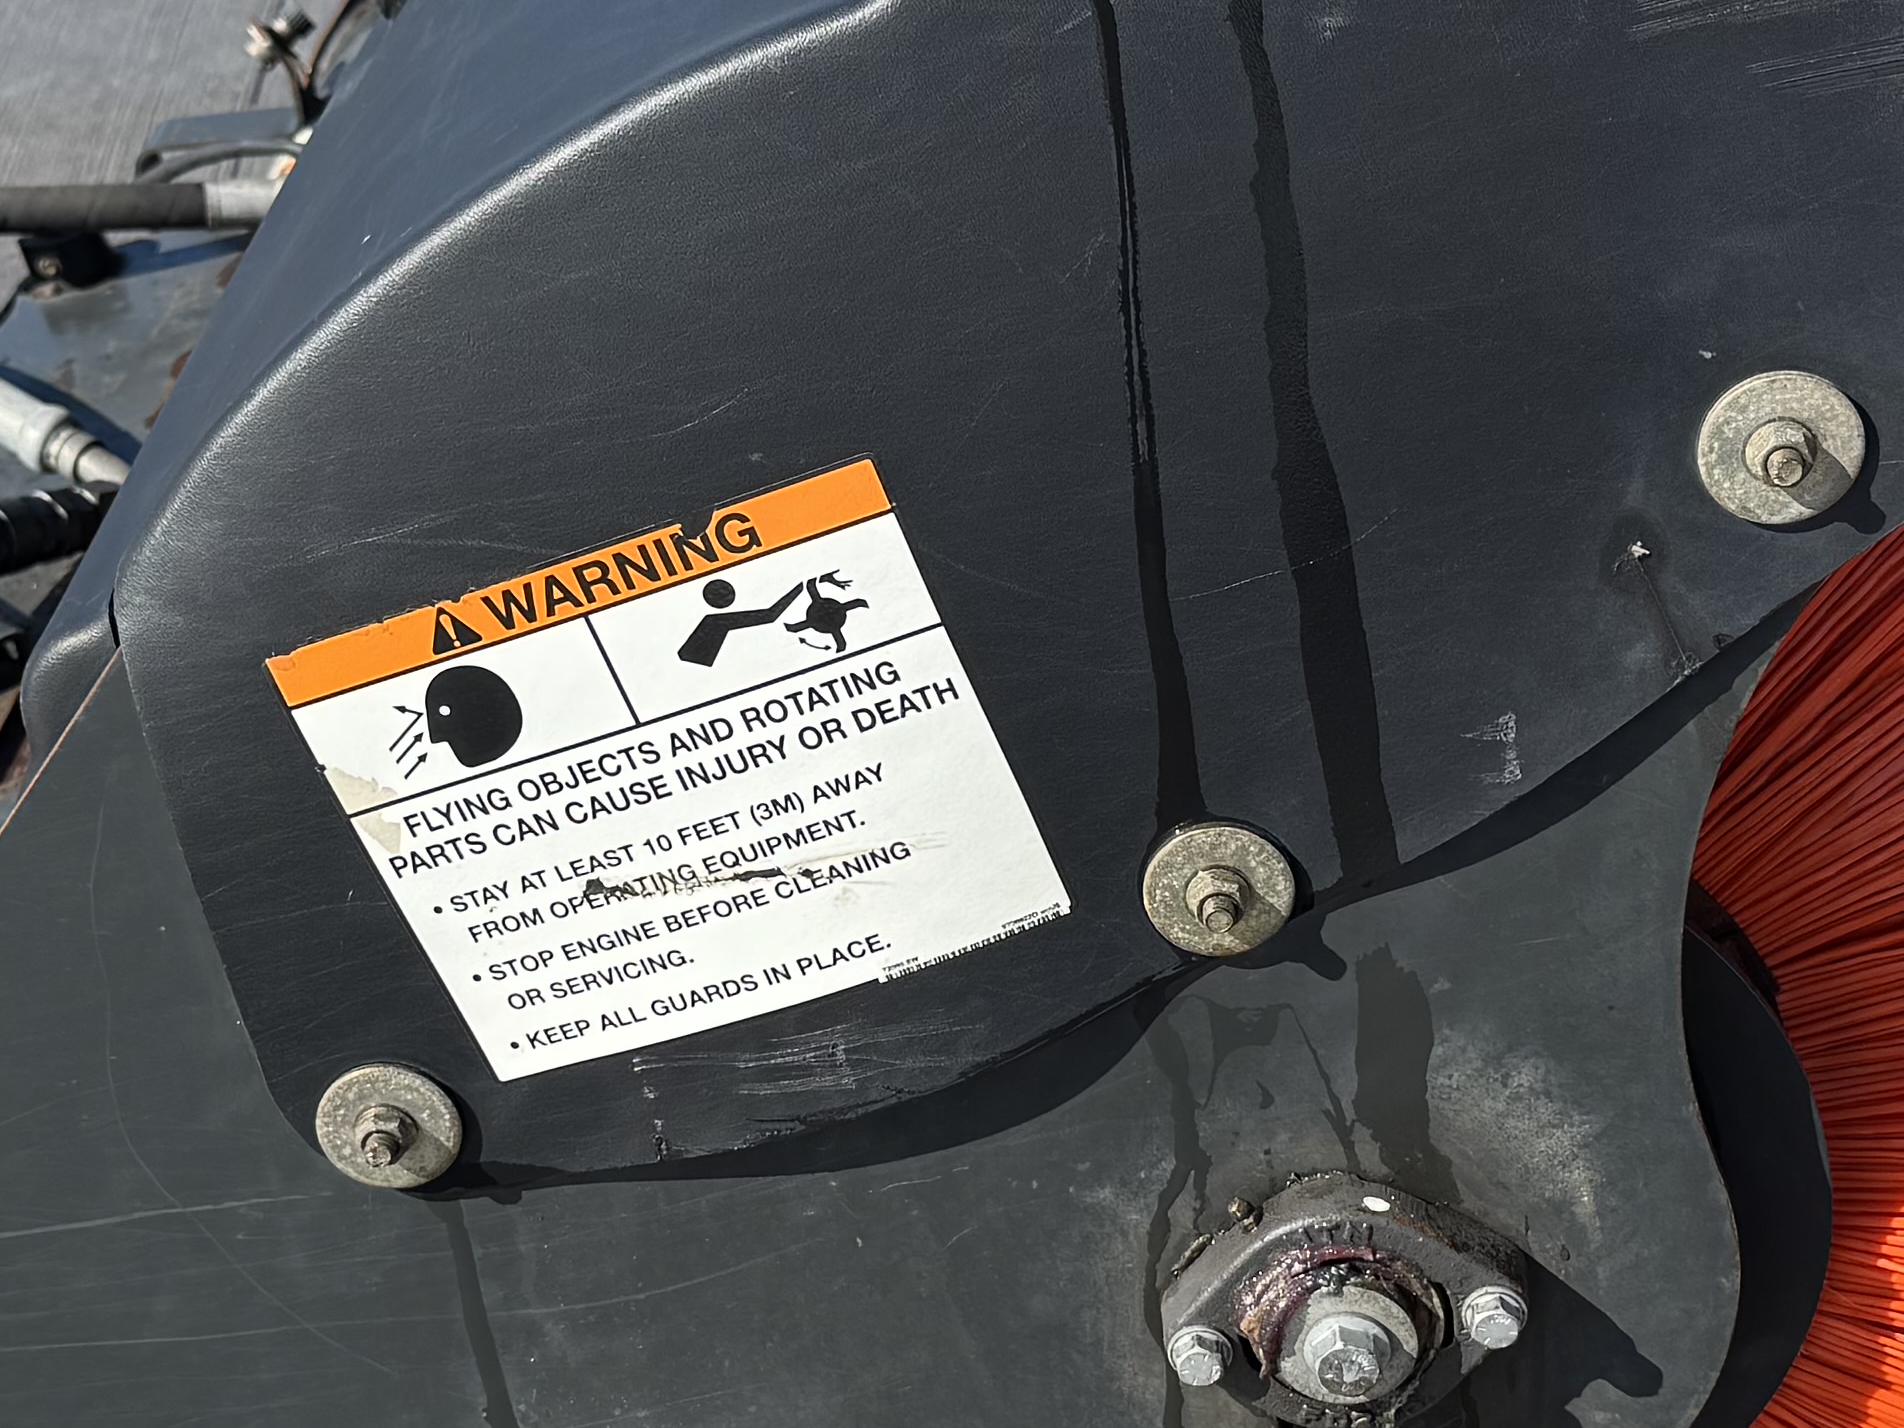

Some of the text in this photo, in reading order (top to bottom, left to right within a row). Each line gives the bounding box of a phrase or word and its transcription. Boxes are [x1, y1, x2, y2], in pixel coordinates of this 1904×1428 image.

[481, 512, 762, 630] WARNING
[388, 677, 961, 879] PARTS CAN CAUSE INJURY OR DEATH
[403, 660, 901, 838] FLYING OBJECTS AND ROTATING
[449, 762, 884, 914] STAY AT LEAST 10 FEET (3M) AWAY
[468, 810, 867, 944] FROM OPERATING EQUIPMENT.
[488, 841, 912, 981] STOP ENGINE BEFORE CLEANING
[507, 949, 695, 1011] OR SERVICING.
[526, 1018, 591, 1050] KEEP
[599, 1006, 648, 1032] ALL
[650, 973, 760, 1018] GUARDS
[764, 967, 793, 987] IN
[799, 933, 893, 977] PLACE.
